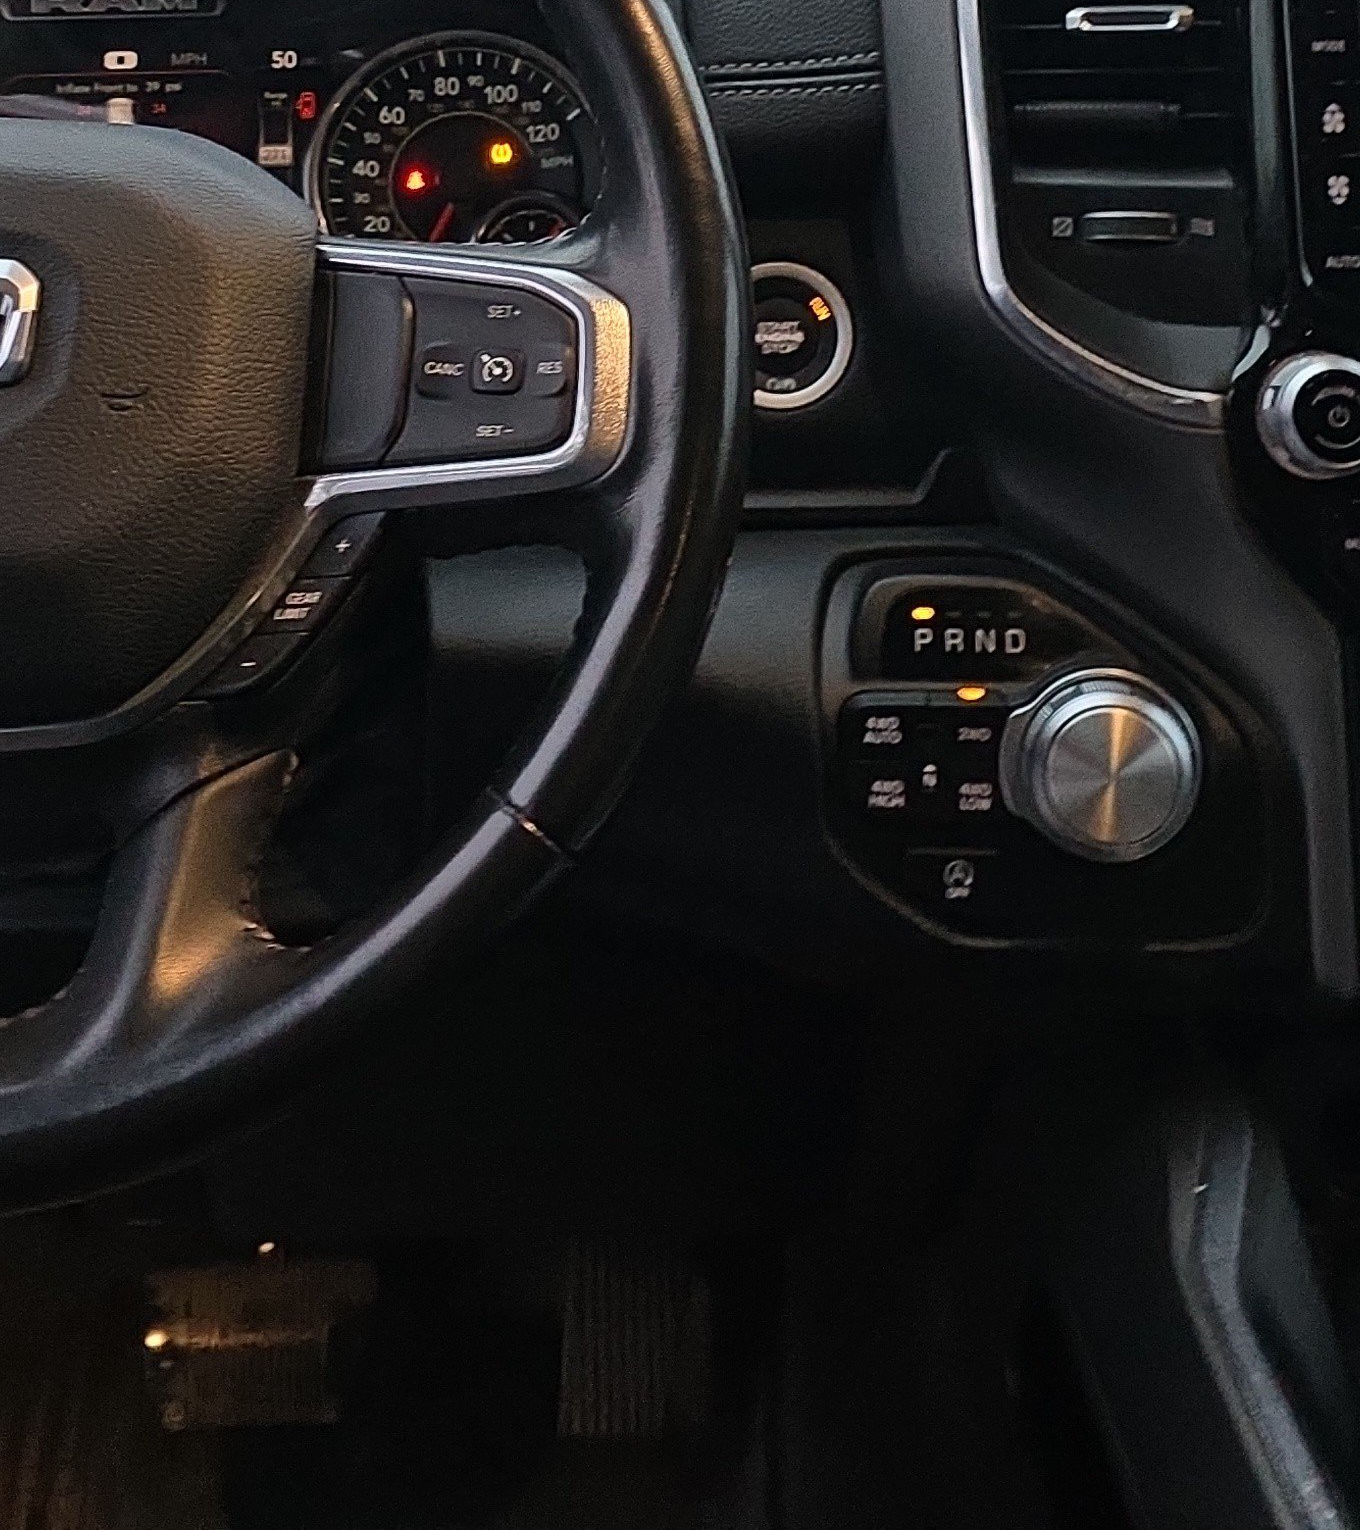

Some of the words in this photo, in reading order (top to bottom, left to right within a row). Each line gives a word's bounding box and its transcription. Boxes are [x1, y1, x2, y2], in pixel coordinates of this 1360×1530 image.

[103, 50, 138, 70] 0
[170, 51, 207, 67] MPH
[270, 50, 297, 70] 50
[408, 88, 426, 102] 70
[433, 76, 460, 96] 80
[484, 83, 519, 104] 100
[378, 105, 405, 125] 60
[525, 122, 560, 144] 120
[352, 159, 380, 178] 40
[363, 214, 391, 234] 20
[424, 360, 465, 376] CANC
[536, 360, 563, 375] RES
[913, 627, 934, 653] P
[943, 627, 965, 653] R
[973, 628, 998, 654] N
[1003, 628, 1028, 655] D
